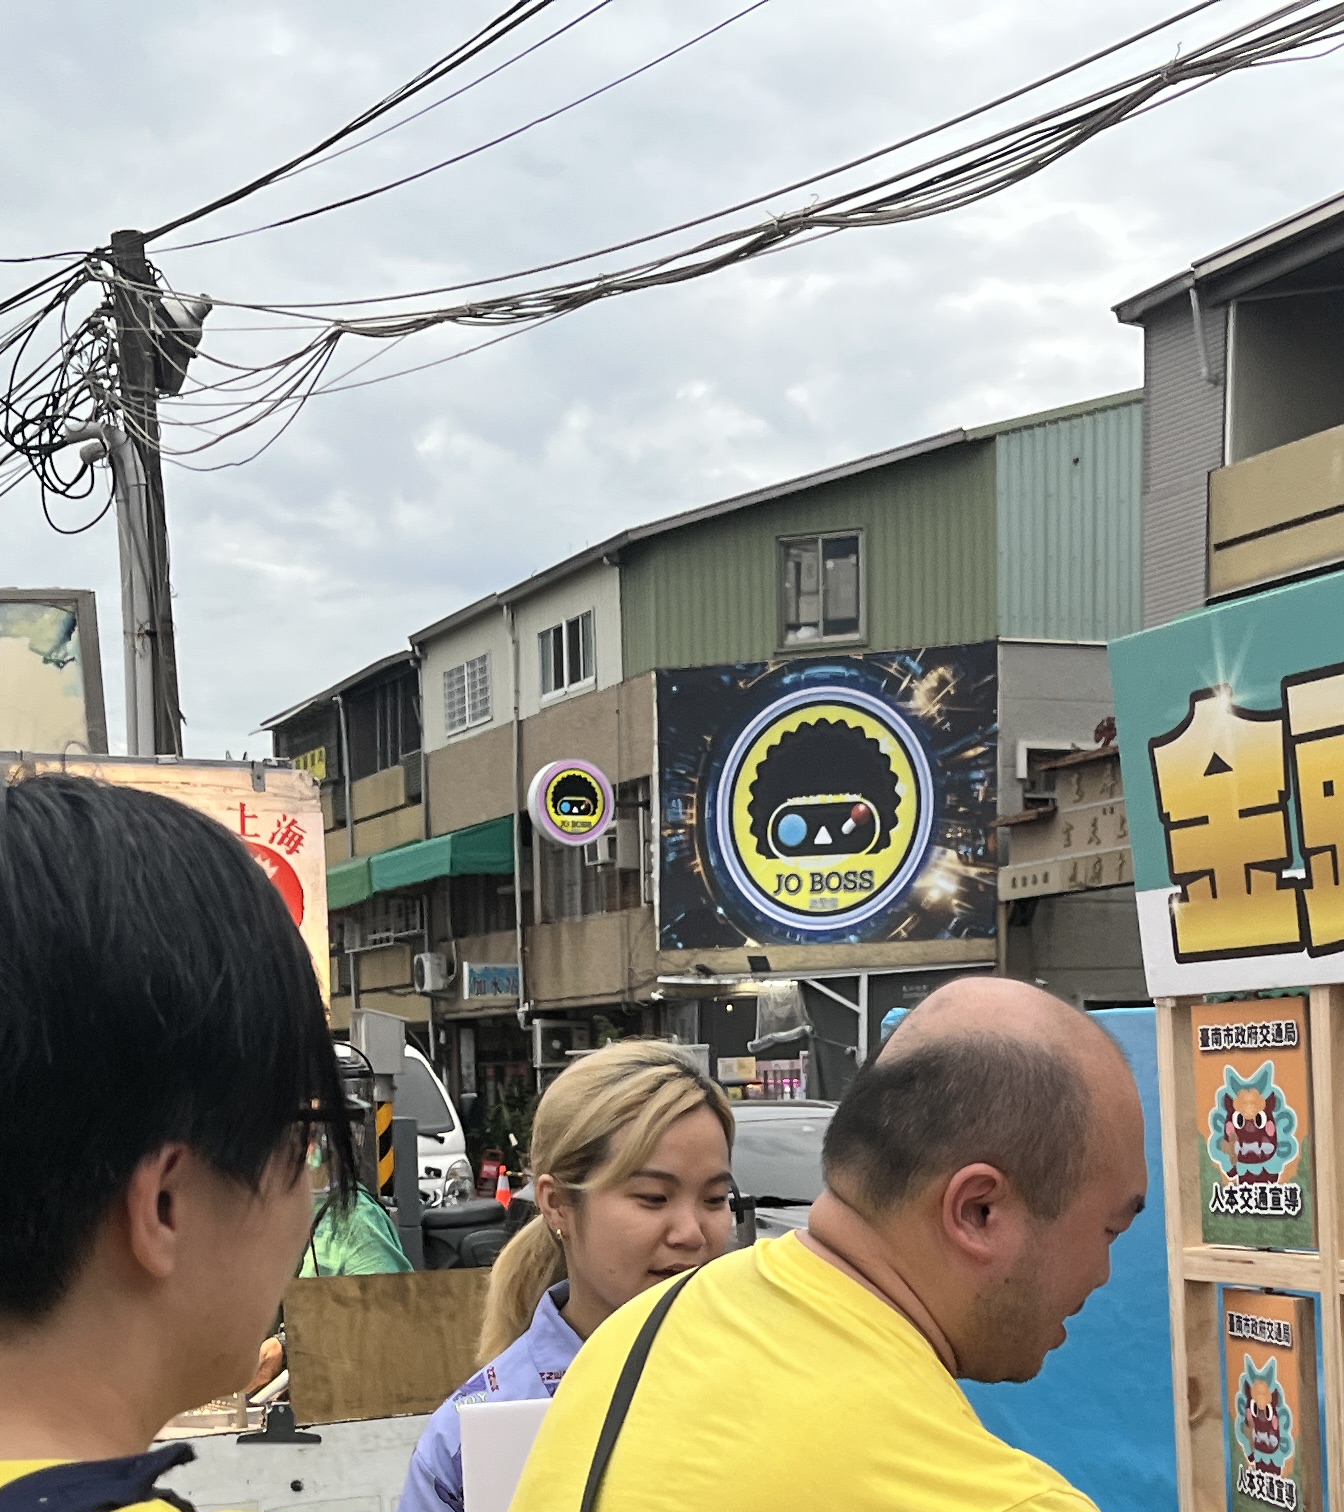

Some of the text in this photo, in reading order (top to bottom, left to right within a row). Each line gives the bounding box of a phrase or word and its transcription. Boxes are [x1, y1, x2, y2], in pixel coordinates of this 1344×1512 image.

[235, 802, 310, 856] 上海
[773, 870, 874, 895] JO BOSS
[1199, 1020, 1297, 1049] 臺南市政府交通局
[1210, 1182, 1302, 1214] 人本交通宣導
[1238, 1465, 1297, 1511] 人本交通宣導
